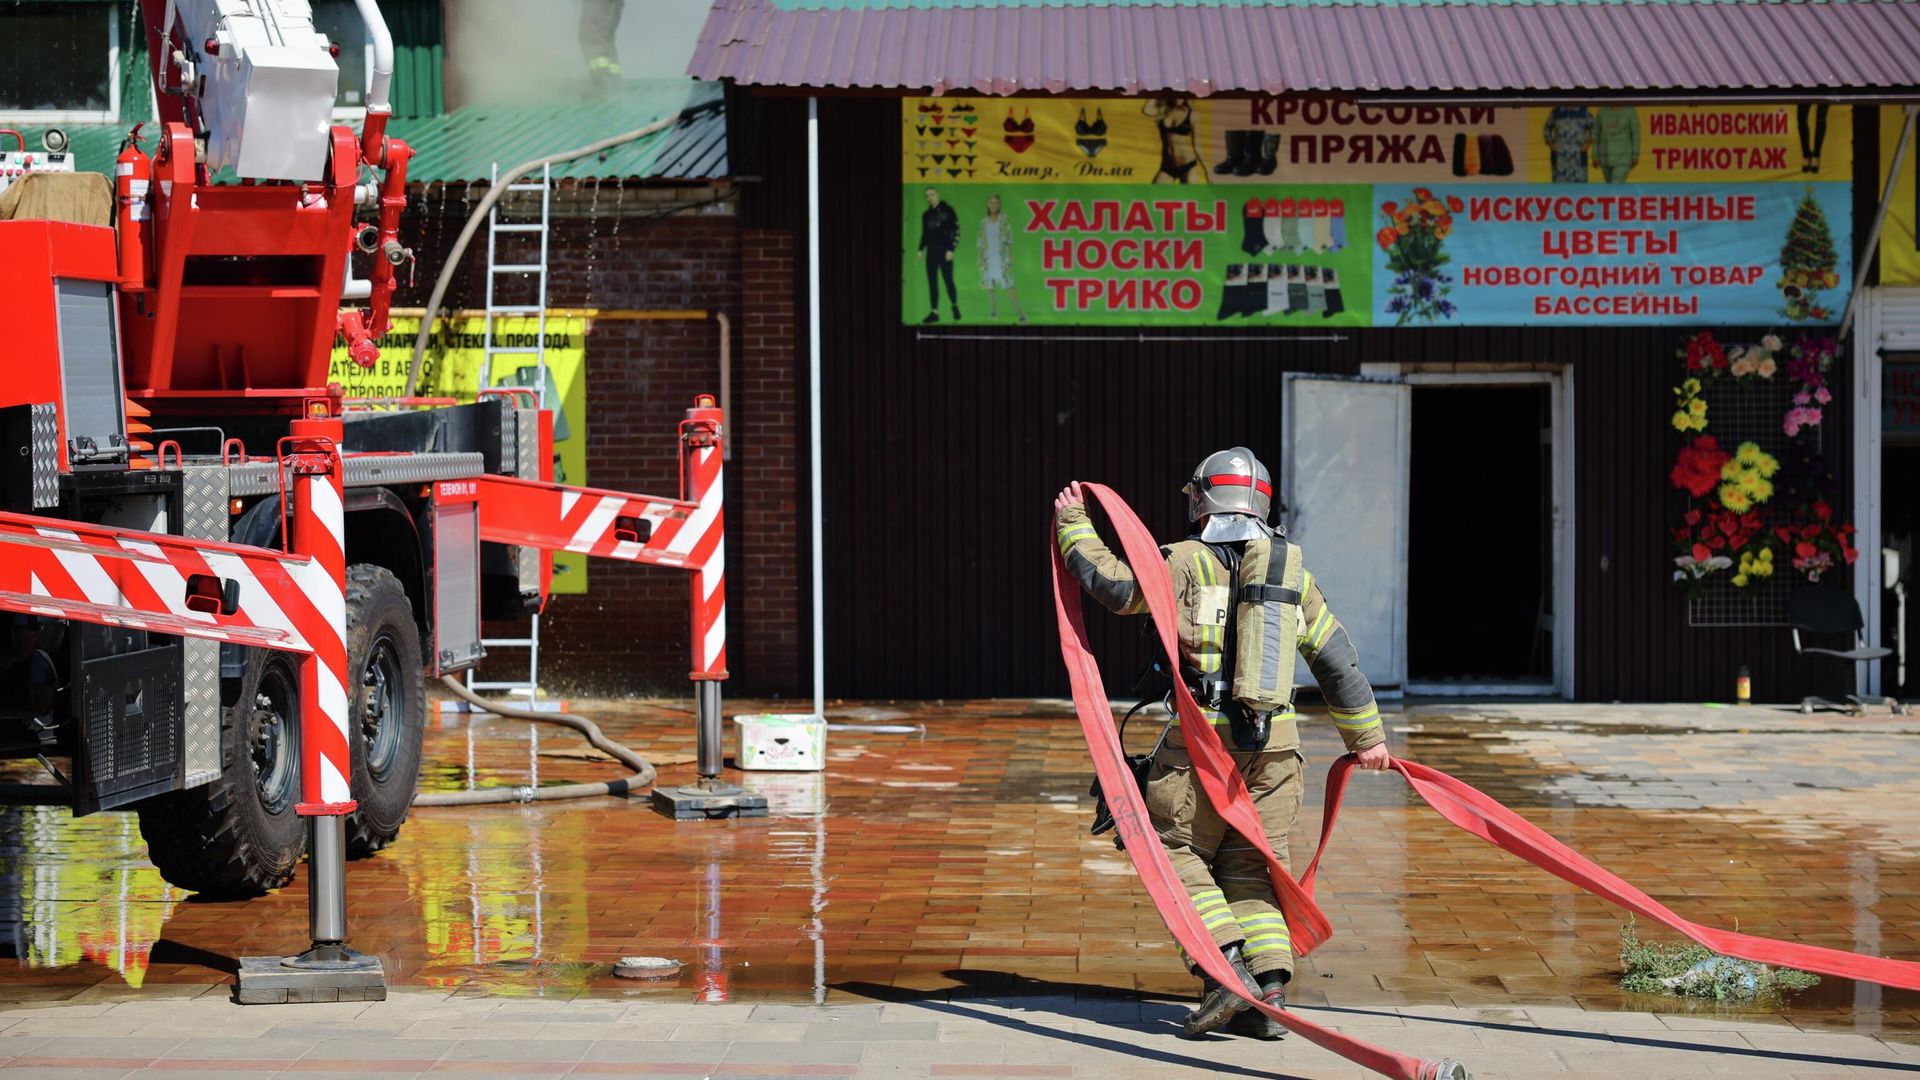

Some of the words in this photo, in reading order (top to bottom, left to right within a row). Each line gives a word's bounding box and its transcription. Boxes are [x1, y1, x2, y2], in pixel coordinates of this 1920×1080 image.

[1251, 99, 1495, 125] КРОССОВКИ
[1650, 108, 1788, 135] ИВАНОВСКИЙ
[1290, 134, 1446, 164] ПРЯЖА
[1652, 147, 1787, 170] ТРИКОТАЖ
[1026, 201, 1227, 231] ХАЛАТЫ
[1470, 196, 1756, 221] ИСКУССТВЕННЫЕ
[1043, 239, 1204, 270] НОСКИ
[1542, 230, 1678, 258] ЦВЕТЫ
[1463, 263, 1661, 287] НОВОГОДНИЙ
[1671, 266, 1764, 284] ТОВАР
[1047, 279, 1202, 310] ТРИКО
[1534, 291, 1698, 315] БАССЕЙНЫ
[506, 334, 570, 350] ПРОВОДА
[331, 361, 376, 376] АТЕЛИ
[382, 361, 390, 376] В
[395, 361, 432, 377] АВО
